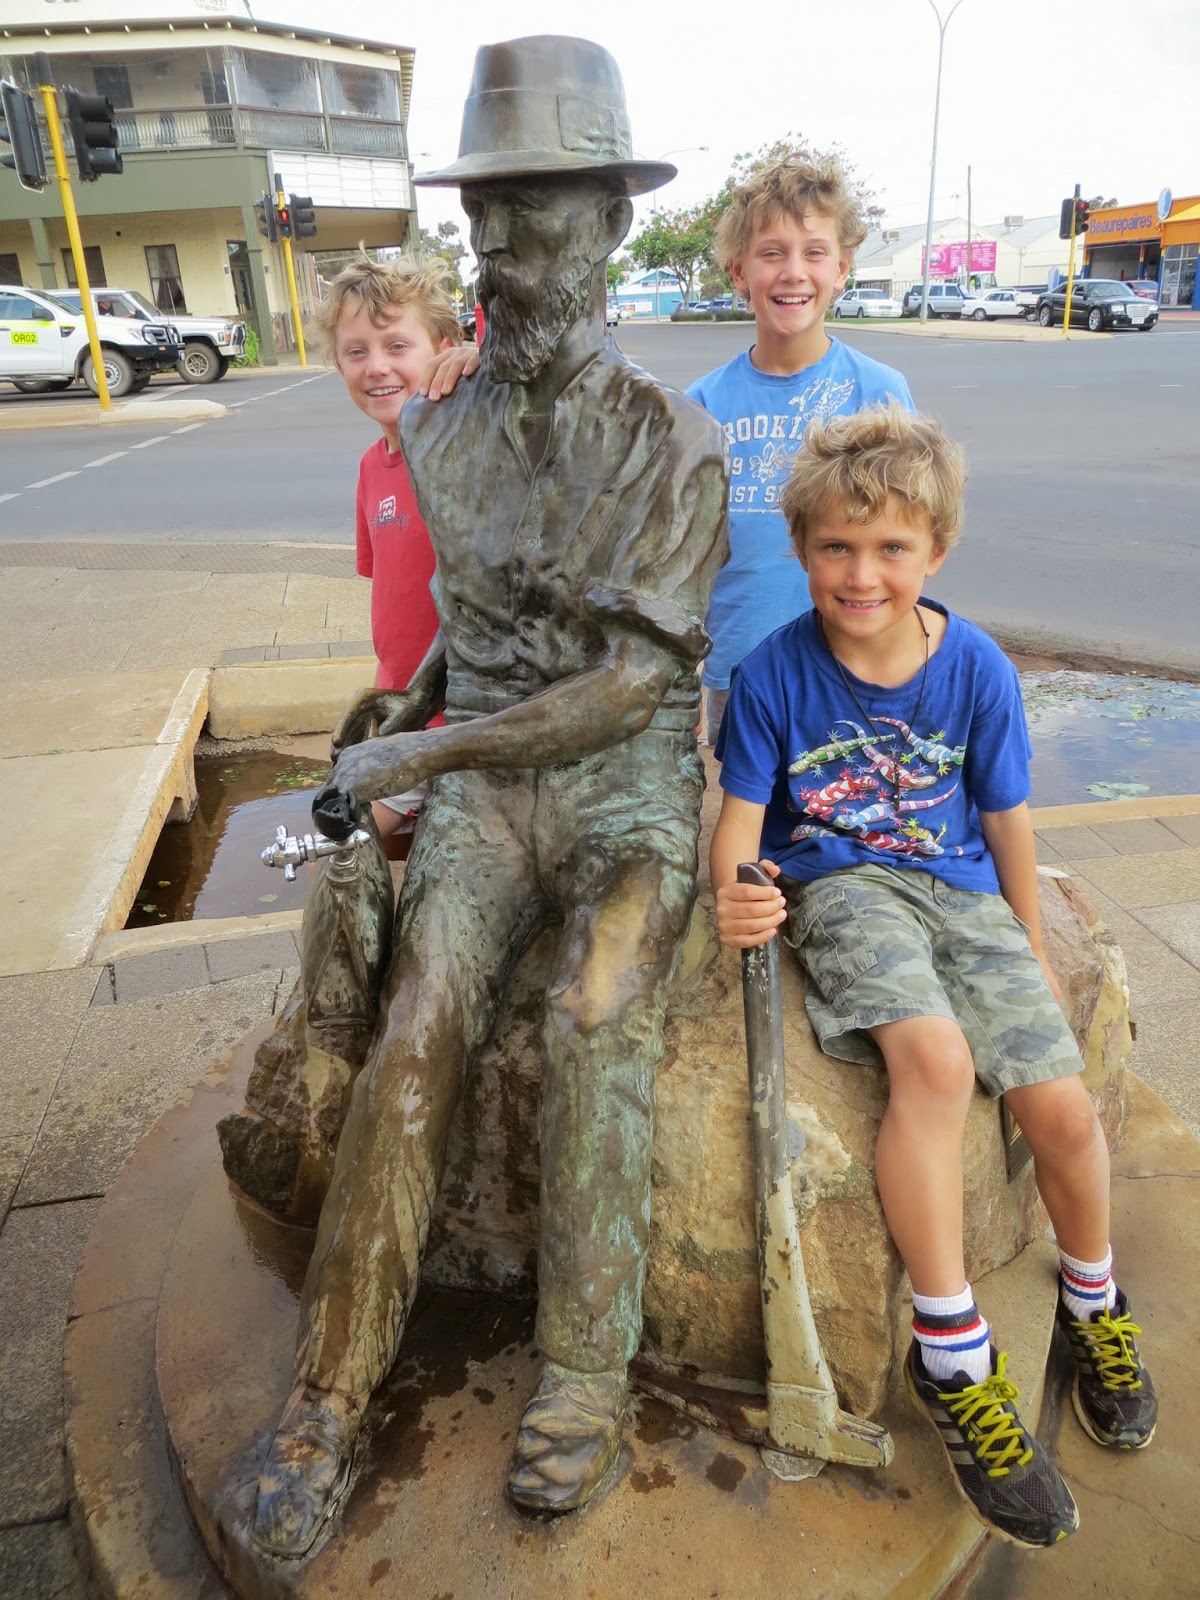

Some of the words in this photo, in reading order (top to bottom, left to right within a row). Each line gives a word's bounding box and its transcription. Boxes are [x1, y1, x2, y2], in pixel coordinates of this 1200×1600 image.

[1089, 213, 1152, 235] Beaurepaires
[13, 333, 37, 343] OR02
[722, 414, 803, 445] ROOKL
